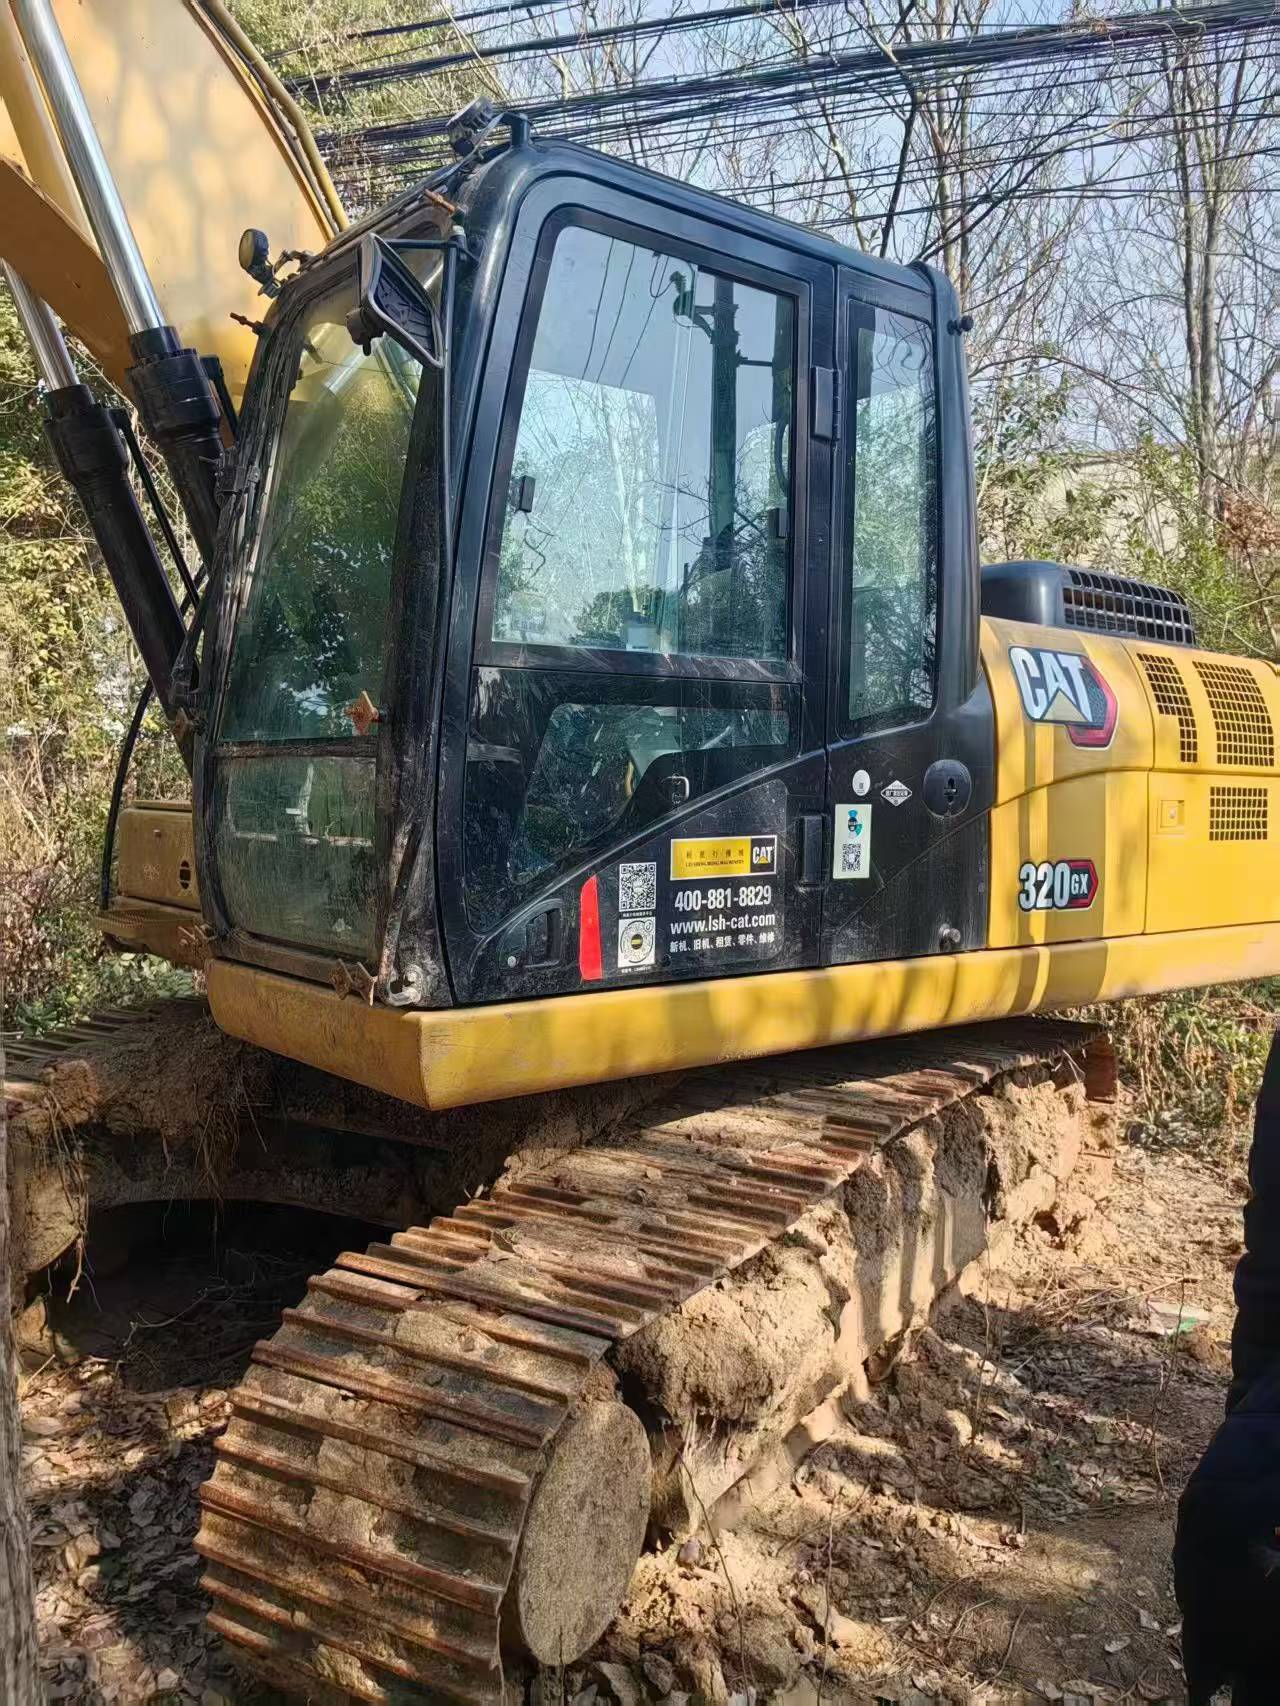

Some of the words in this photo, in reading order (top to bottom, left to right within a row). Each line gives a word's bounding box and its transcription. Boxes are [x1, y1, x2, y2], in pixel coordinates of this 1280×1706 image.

[1010, 647, 1093, 722] CAT
[752, 846, 774, 865] CAT
[674, 885, 772, 912] 400-881-8829
[670, 914, 776, 935] www.lsh-cat.com
